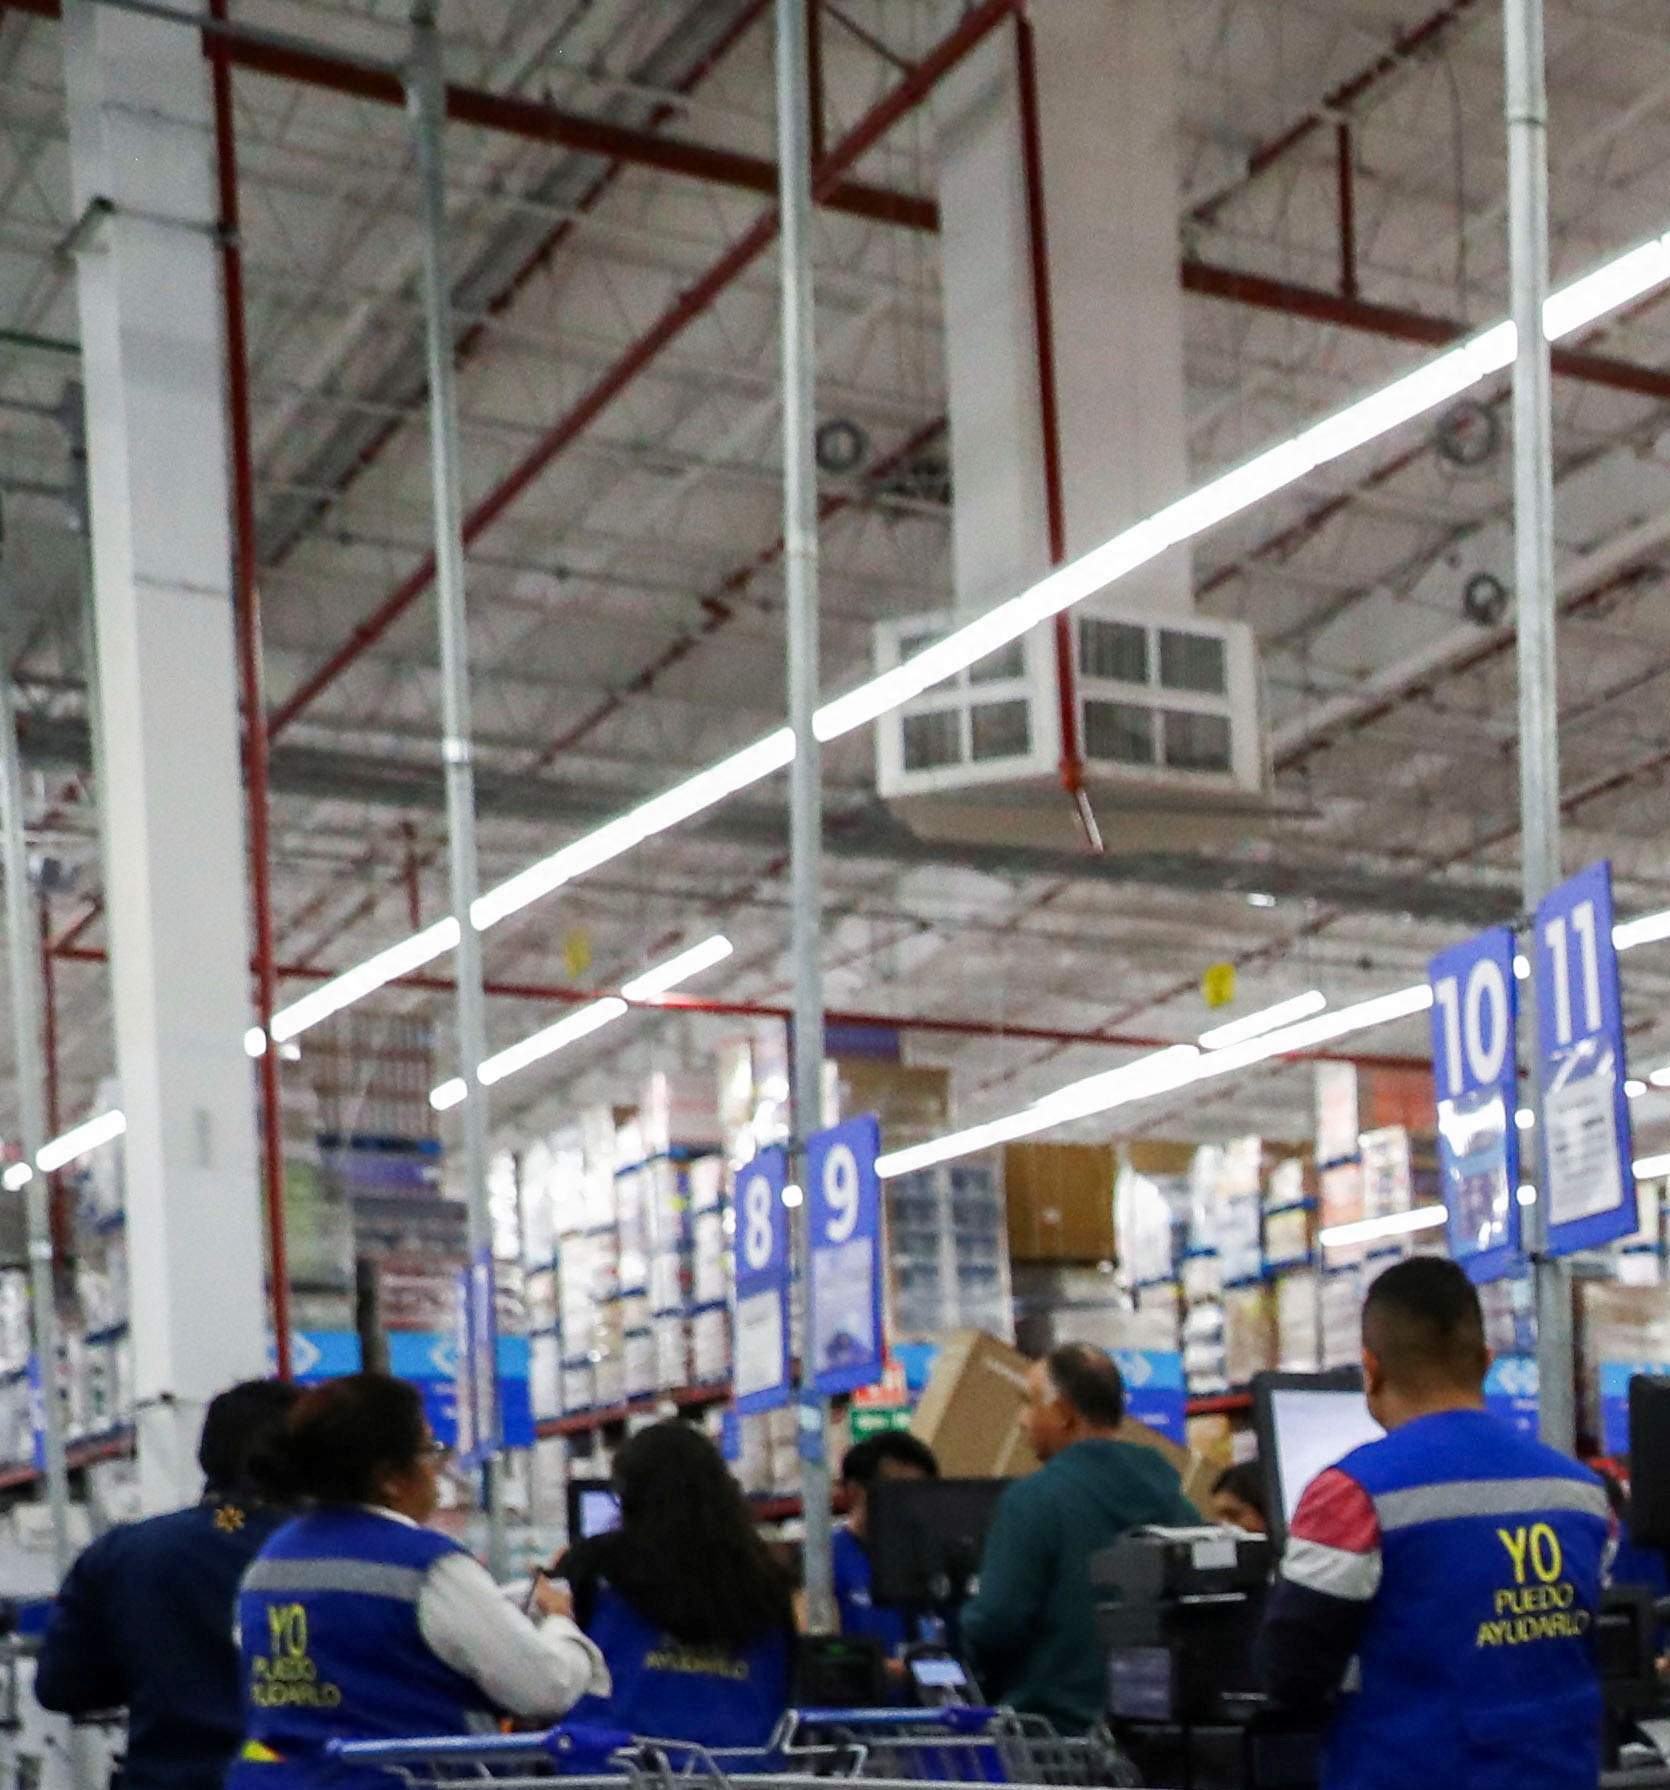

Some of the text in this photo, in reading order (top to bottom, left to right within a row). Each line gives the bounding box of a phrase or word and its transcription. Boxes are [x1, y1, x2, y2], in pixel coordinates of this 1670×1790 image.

[1545, 900, 1601, 1044] 11
[1435, 958, 1508, 1096] 10
[742, 1174, 774, 1270] 8
[822, 1142, 860, 1242] 9
[1495, 1582, 1574, 1615] PUEDO
[1496, 1522, 1562, 1583] YO
[267, 1602, 307, 1656] YO
